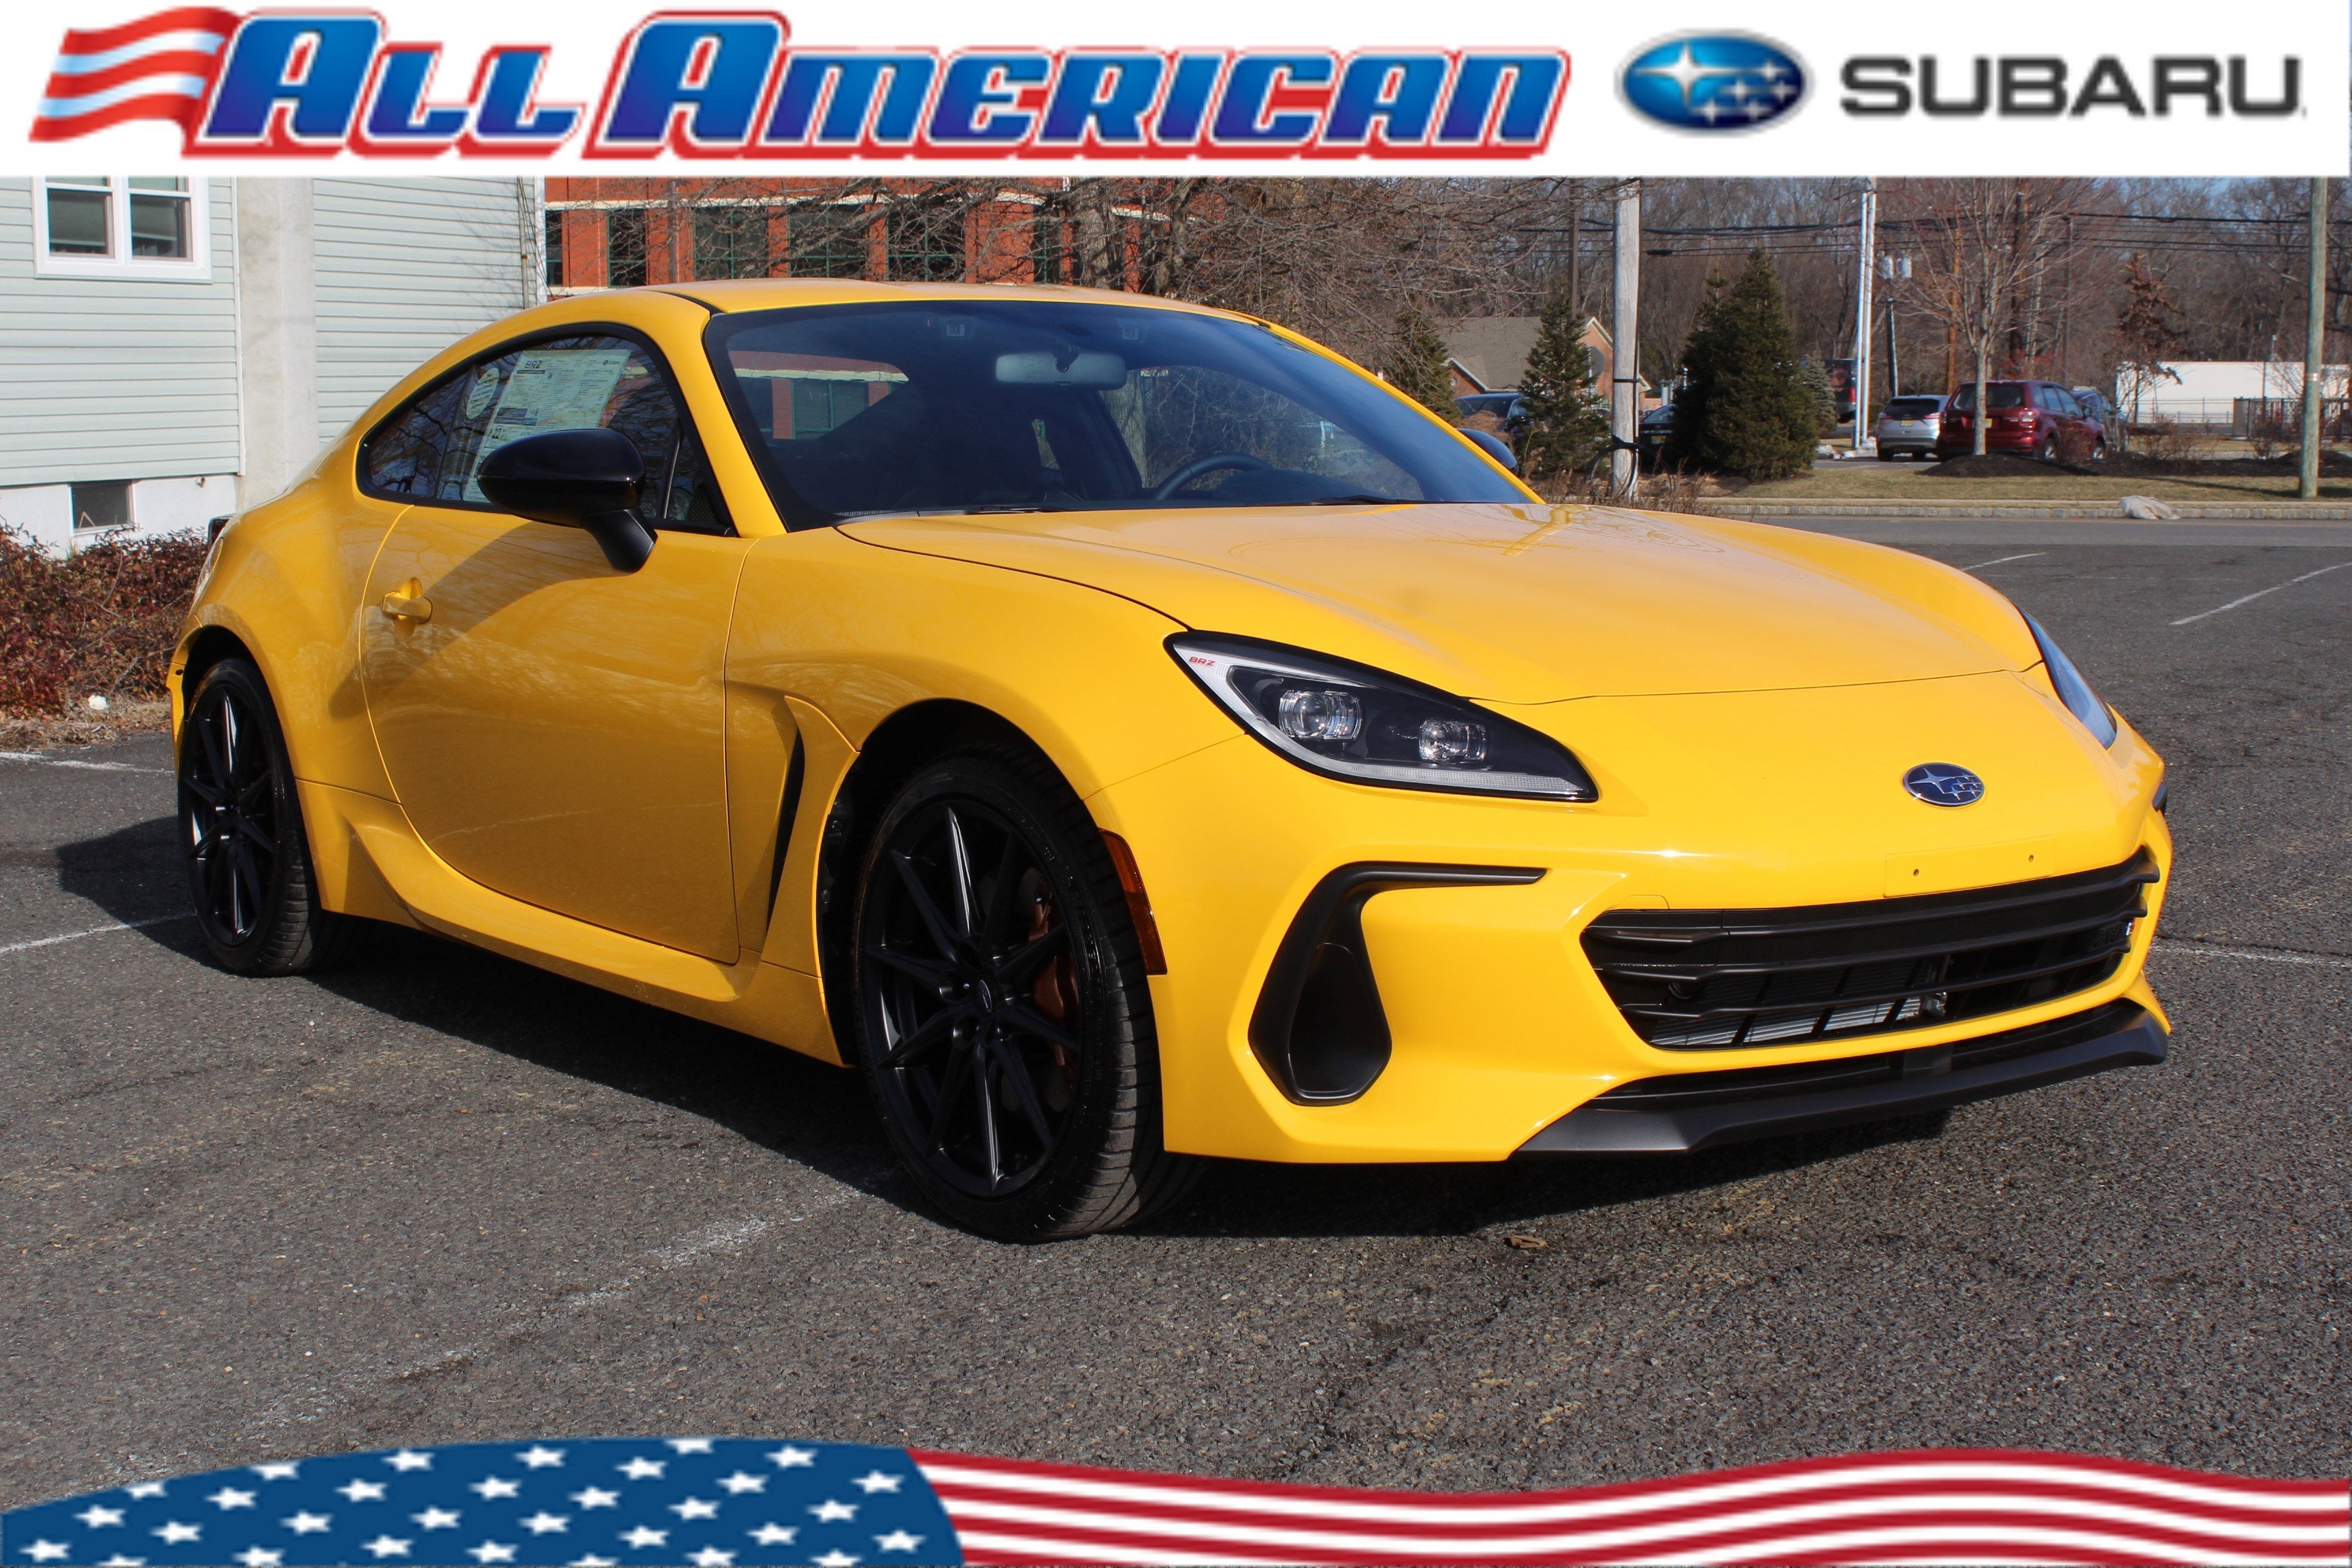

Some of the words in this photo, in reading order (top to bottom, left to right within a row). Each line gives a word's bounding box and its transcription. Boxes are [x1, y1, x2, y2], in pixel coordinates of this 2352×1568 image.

[525, 360, 543, 369] BRZ
[491, 427, 502, 439] 22
[1189, 656, 1216, 666] BRZ
